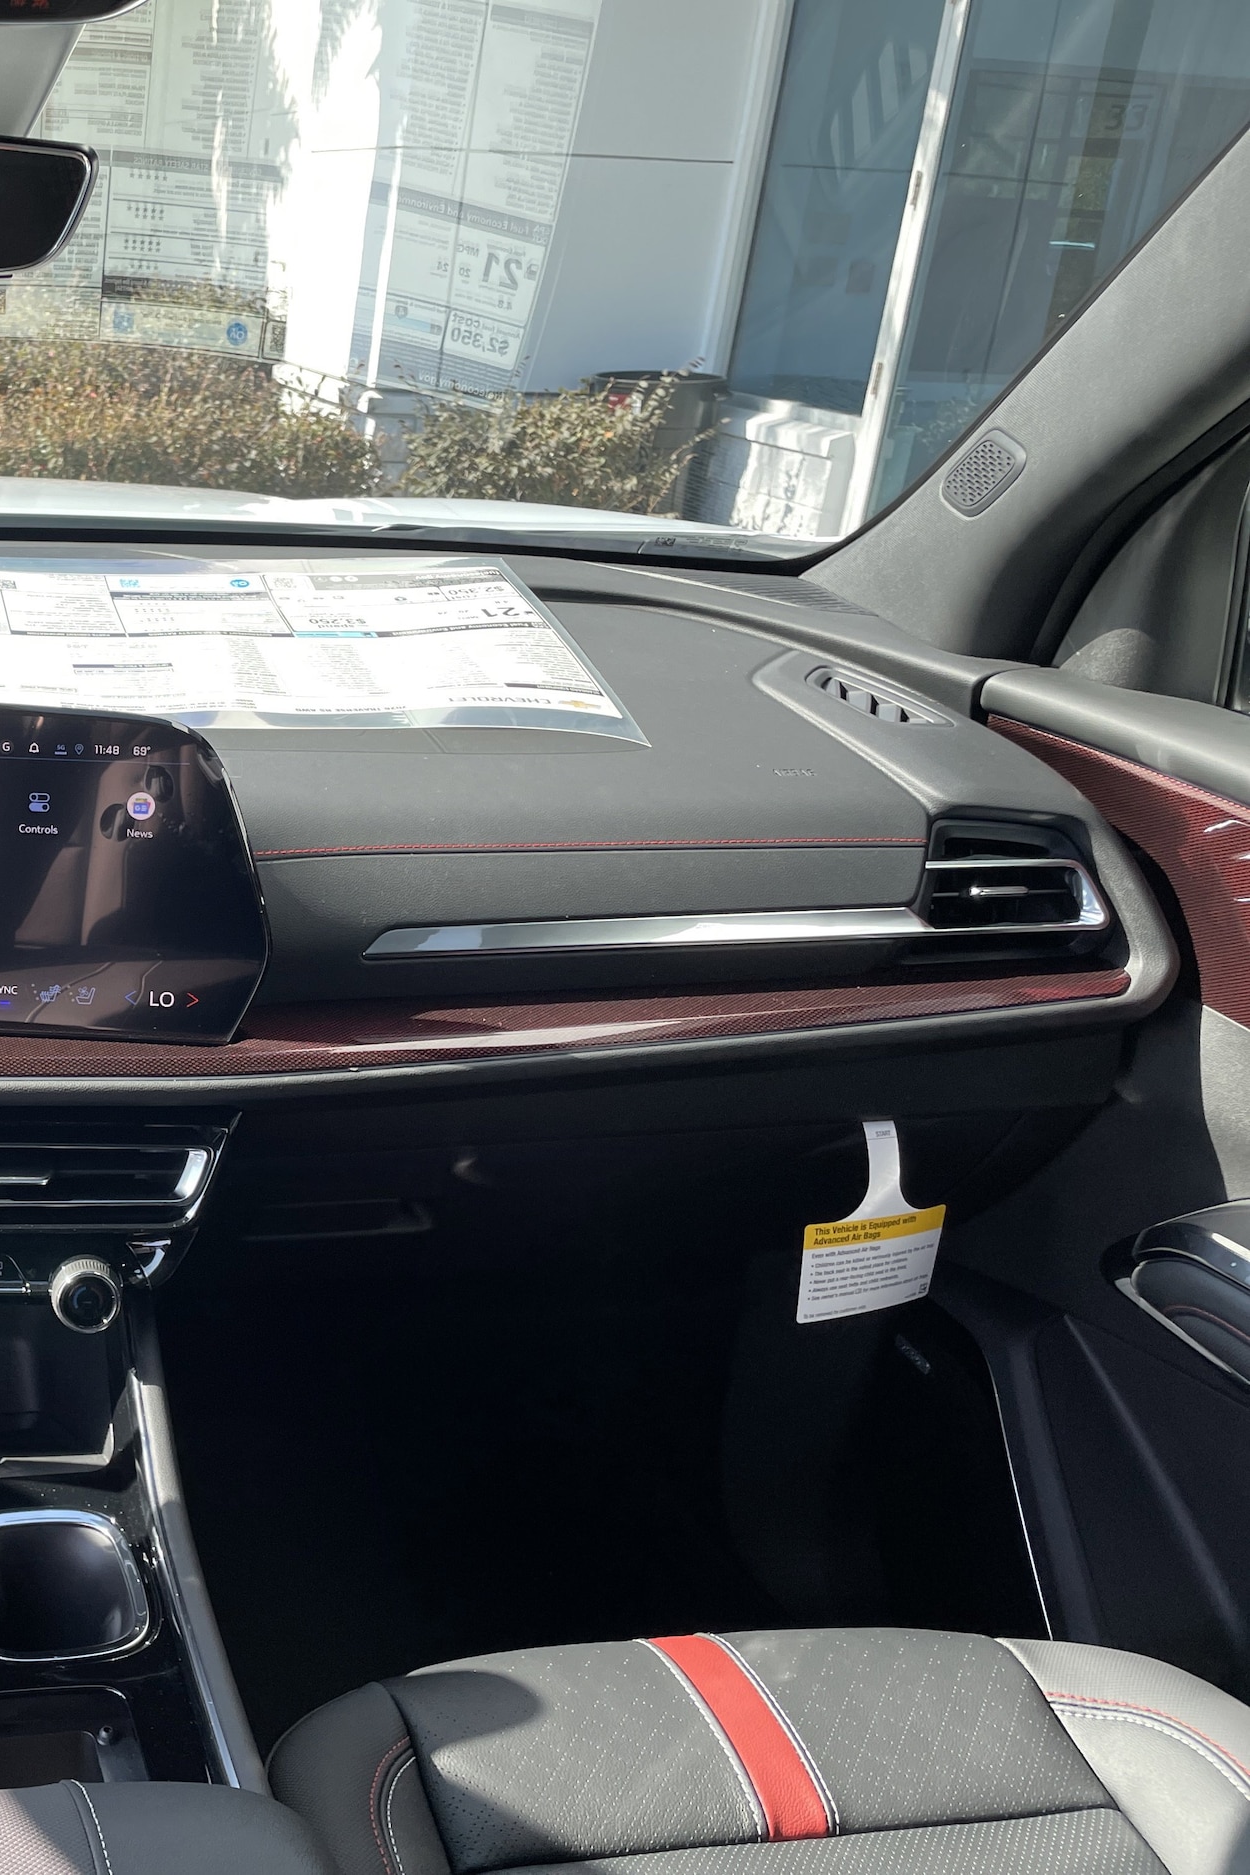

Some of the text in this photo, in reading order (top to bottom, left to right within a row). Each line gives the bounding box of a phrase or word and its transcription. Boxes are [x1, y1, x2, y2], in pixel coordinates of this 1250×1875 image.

[448, 585, 504, 595] $2,350
[481, 607, 520, 617] 21
[449, 696, 552, 704] CHEVROLET
[94, 744, 151, 756] 11:48 69°
[18, 823, 59, 835] Controls
[126, 828, 154, 839] News
[149, 991, 175, 1008] LO
[815, 1228, 831, 1236] This
[832, 1225, 858, 1234] Vehicle
[868, 1218, 901, 1230] Equipped
[902, 1216, 917, 1224] with
[813, 1231, 881, 1245] Advanced Air Bags
